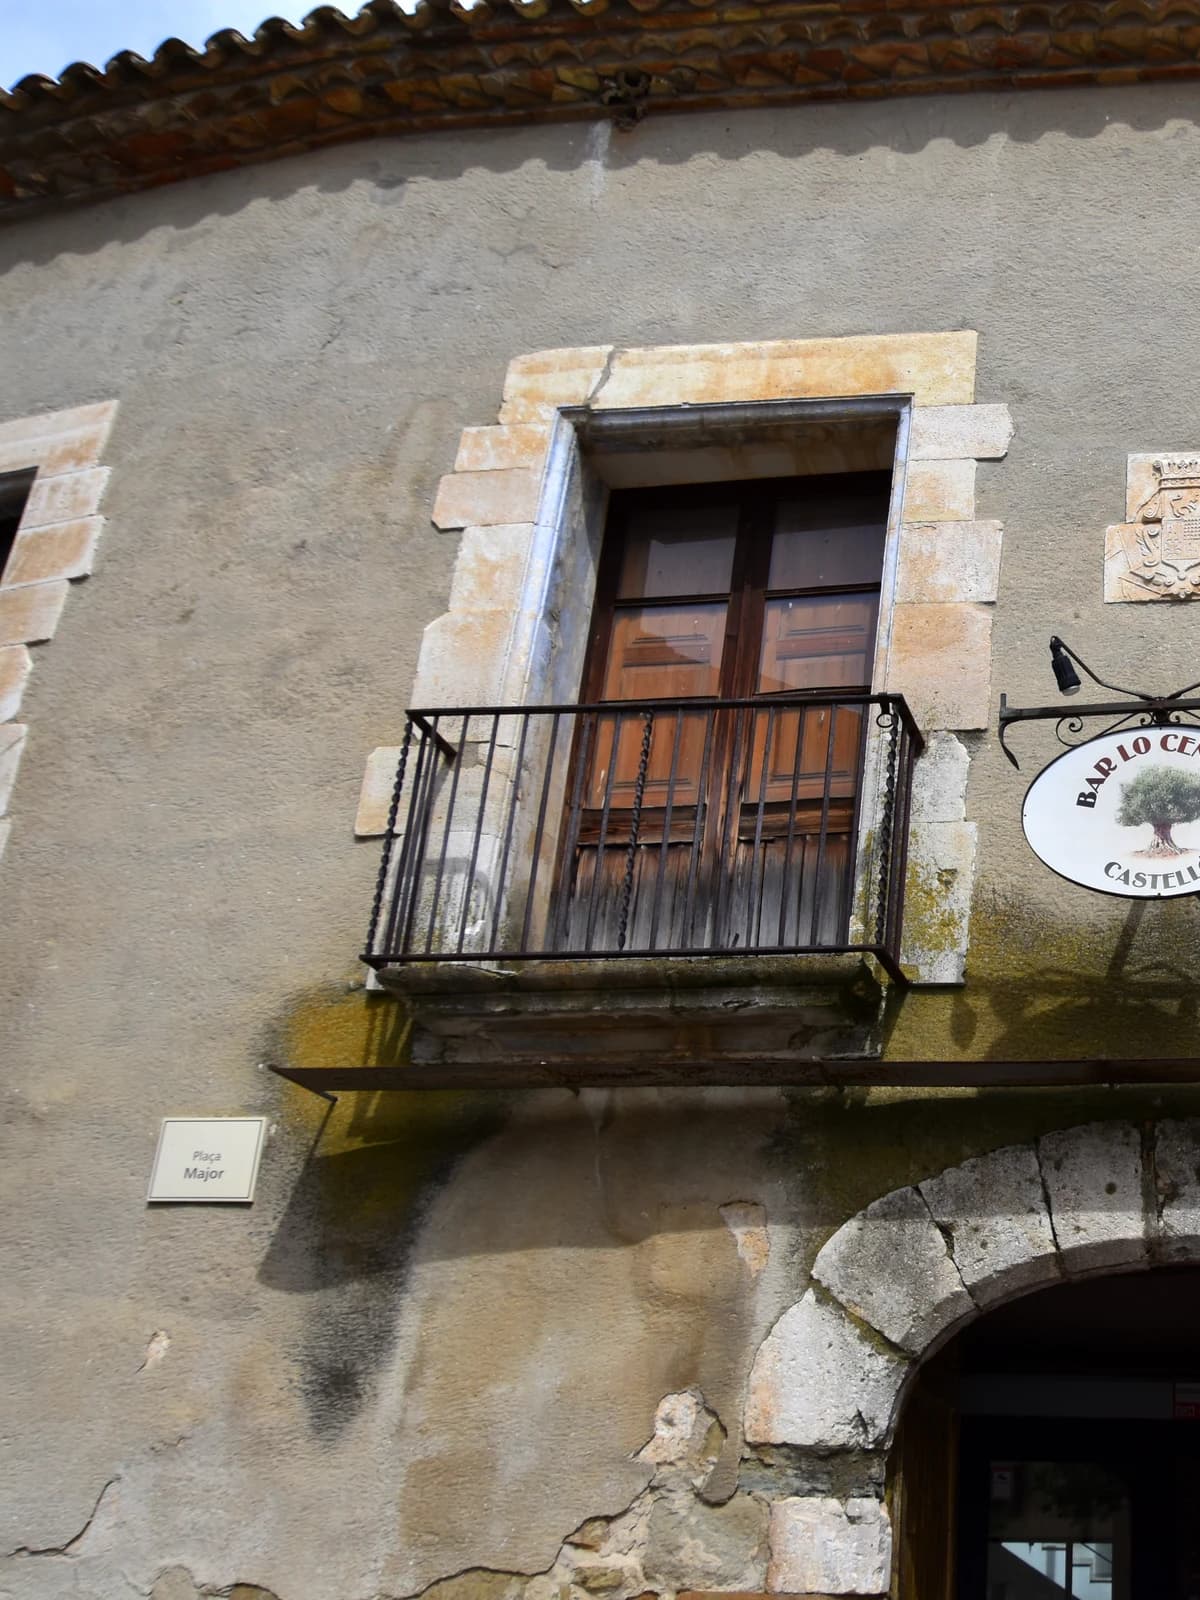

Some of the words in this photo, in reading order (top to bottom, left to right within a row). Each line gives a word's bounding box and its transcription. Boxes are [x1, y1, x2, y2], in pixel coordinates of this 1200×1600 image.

[1076, 757, 1117, 808] BAR
[1117, 736, 1152, 762] LO
[192, 1151, 222, 1164] Plaça
[183, 1167, 224, 1182] Major
